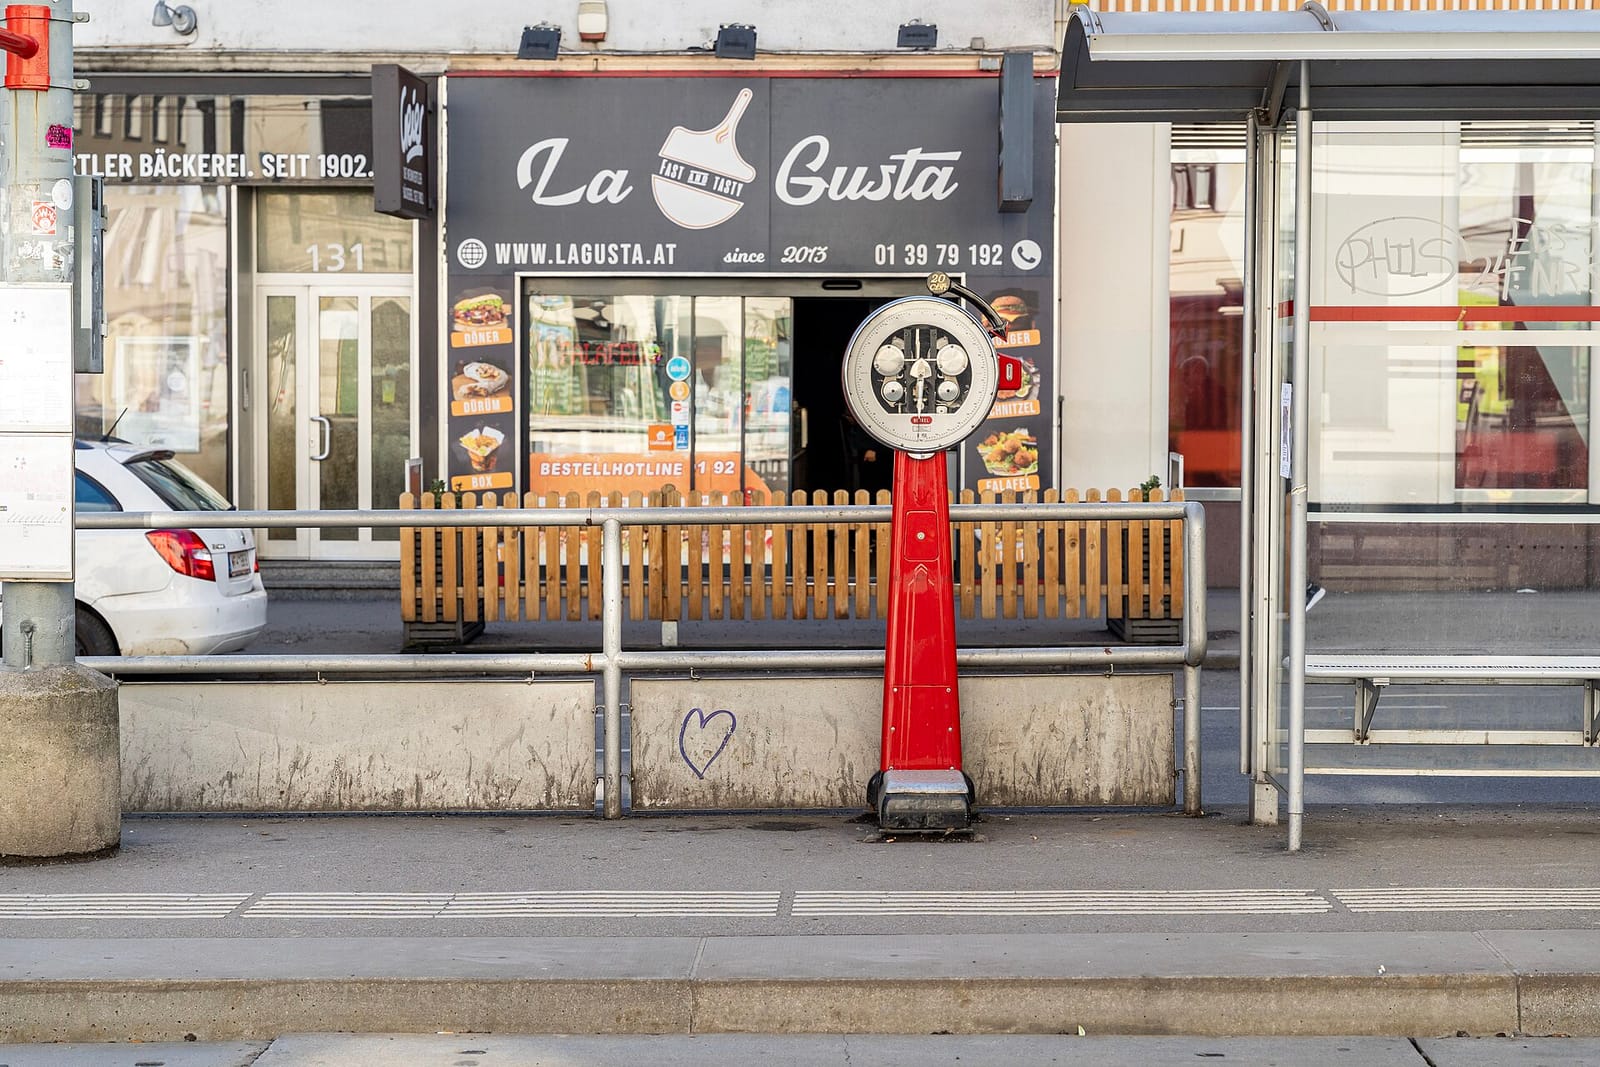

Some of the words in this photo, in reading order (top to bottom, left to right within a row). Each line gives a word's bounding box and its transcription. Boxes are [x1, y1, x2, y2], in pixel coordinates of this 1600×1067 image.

[139, 148, 254, 177] BÄCKEREI.
[261, 153, 310, 177] SEIT
[317, 153, 374, 177] 1902.
[516, 137, 634, 207] La
[774, 134, 962, 206] Gusta
[659, 159, 685, 180] FAST
[687, 170, 710, 186] AND
[713, 176, 744, 197] TASTY
[305, 242, 364, 273] 131
[494, 243, 677, 265] WWW.LAGUSTA.AT
[723, 247, 765, 264] since
[780, 246, 828, 264] 2013
[874, 243, 896, 266] 01
[904, 243, 928, 266] 39
[936, 243, 960, 266] 79
[968, 243, 1002, 266] 192
[930, 273, 946, 283] 20
[463, 331, 499, 345] DÖNER
[463, 398, 500, 413] DÜRÜM
[989, 401, 1036, 418] CHNITZEL
[539, 461, 684, 477] BESTELLHOTLINE
[692, 460, 706, 475] 1
[712, 460, 736, 475] 92
[471, 476, 492, 488] BOX
[985, 475, 1032, 491] FALAFEL
